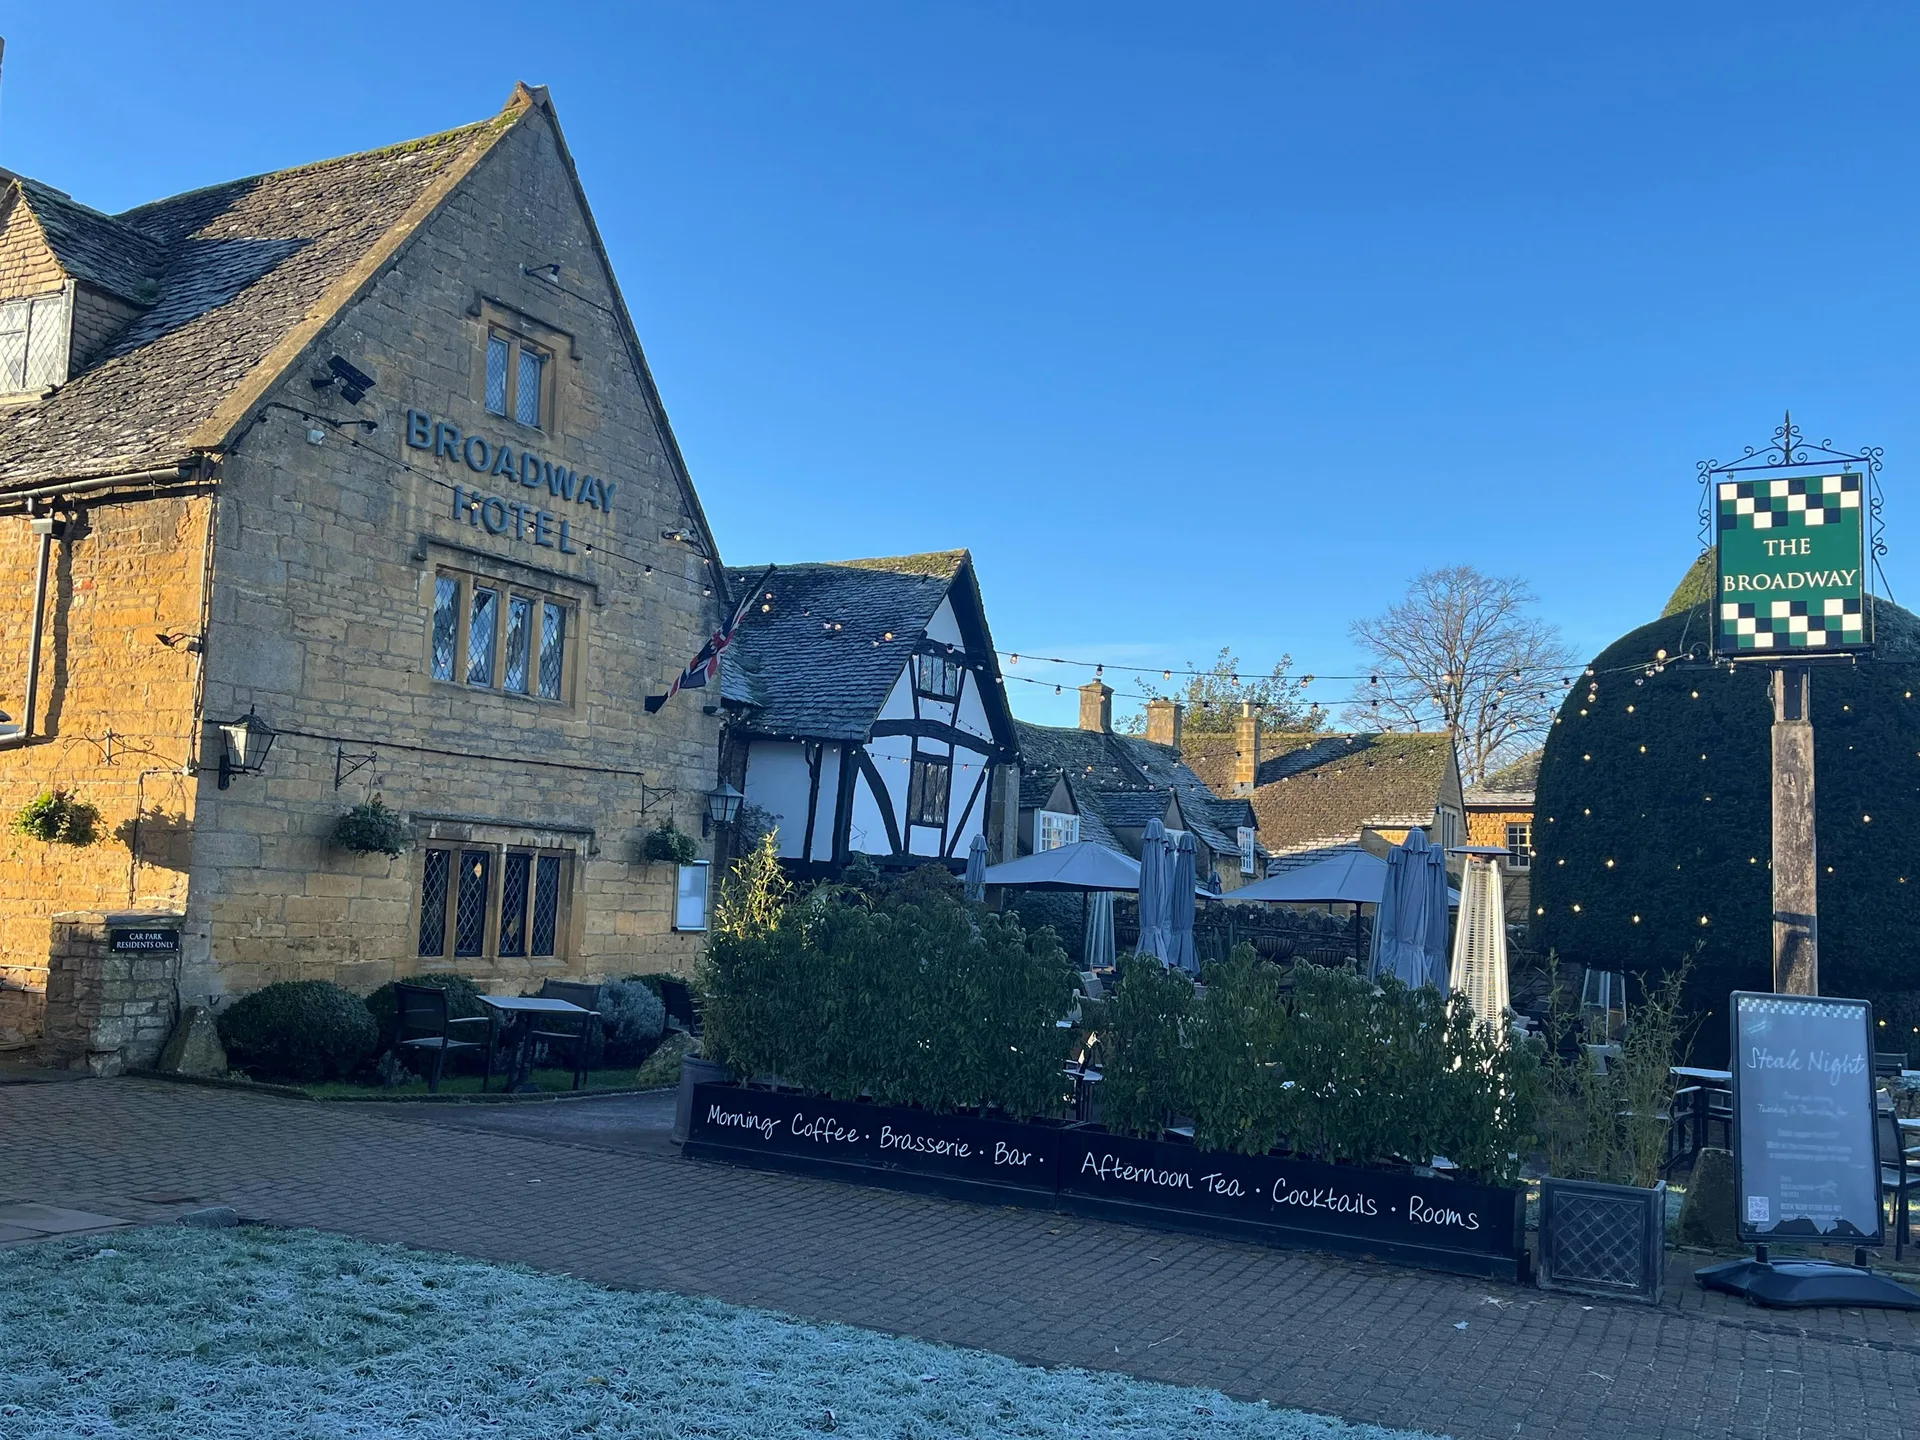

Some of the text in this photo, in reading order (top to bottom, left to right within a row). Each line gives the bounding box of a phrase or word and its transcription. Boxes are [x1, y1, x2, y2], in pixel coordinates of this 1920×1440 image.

[407, 409, 616, 513] BROADWAY
[453, 484, 576, 555] HOTEL
[1763, 538, 1811, 556] THE
[1723, 569, 1857, 592] BROADWAY
[116, 941, 174, 949] RESIDENTS ONLY
[1747, 1047, 1865, 1086] Steak Night
[706, 1104, 1031, 1166] Morning Coffee Brasserie Bar
[1080, 1151, 1480, 1230] Afternoon Tea Cocktails Rooms
